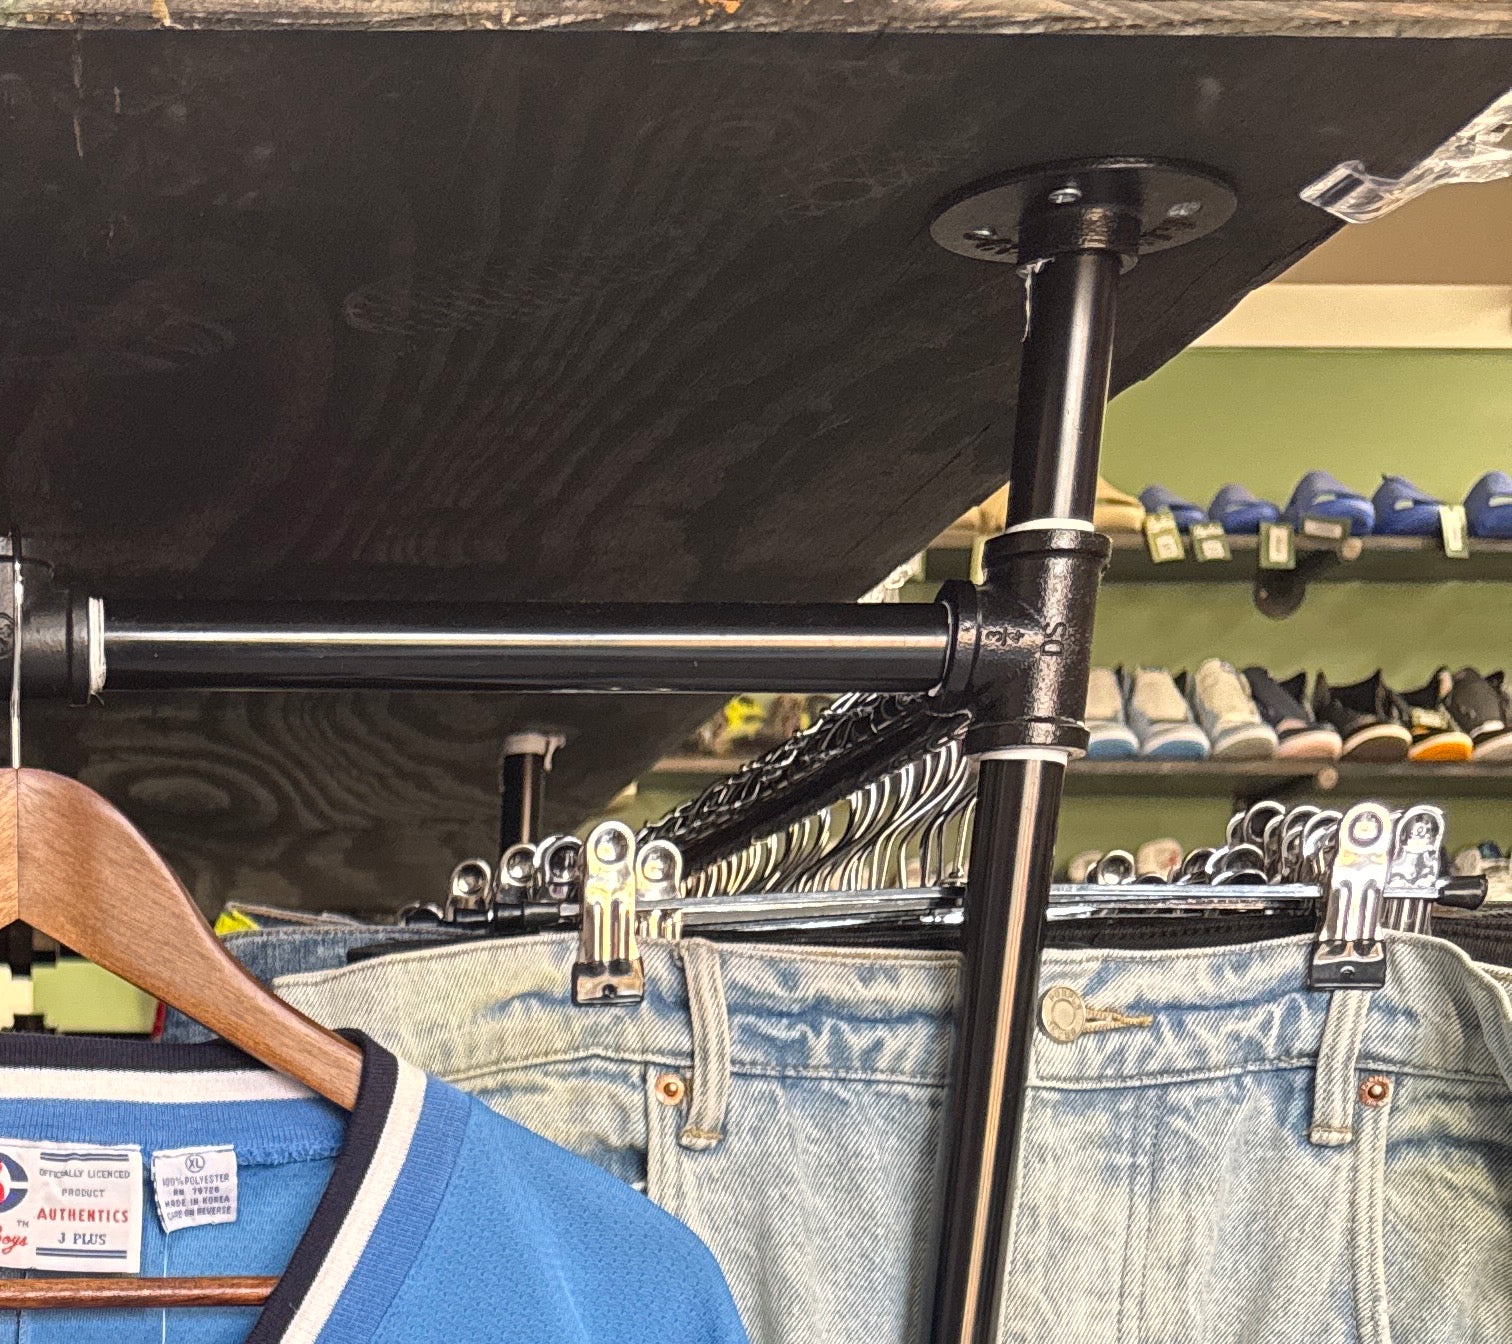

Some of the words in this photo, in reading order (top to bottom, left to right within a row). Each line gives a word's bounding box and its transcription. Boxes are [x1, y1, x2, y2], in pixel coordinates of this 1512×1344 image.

[188, 1157, 203, 1169] XL
[88, 1170, 130, 1179] LICENCED
[61, 1188, 106, 1198] PRODUCT
[165, 1198, 187, 1208] MADE
[190, 1198, 199, 1206] IN
[202, 1195, 231, 1205] KOREA
[37, 1207, 129, 1224] AUTHENTICS
[196, 1205, 232, 1216] REVERSE
[57, 1232, 66, 1244] J
[73, 1233, 107, 1246] PLUS
